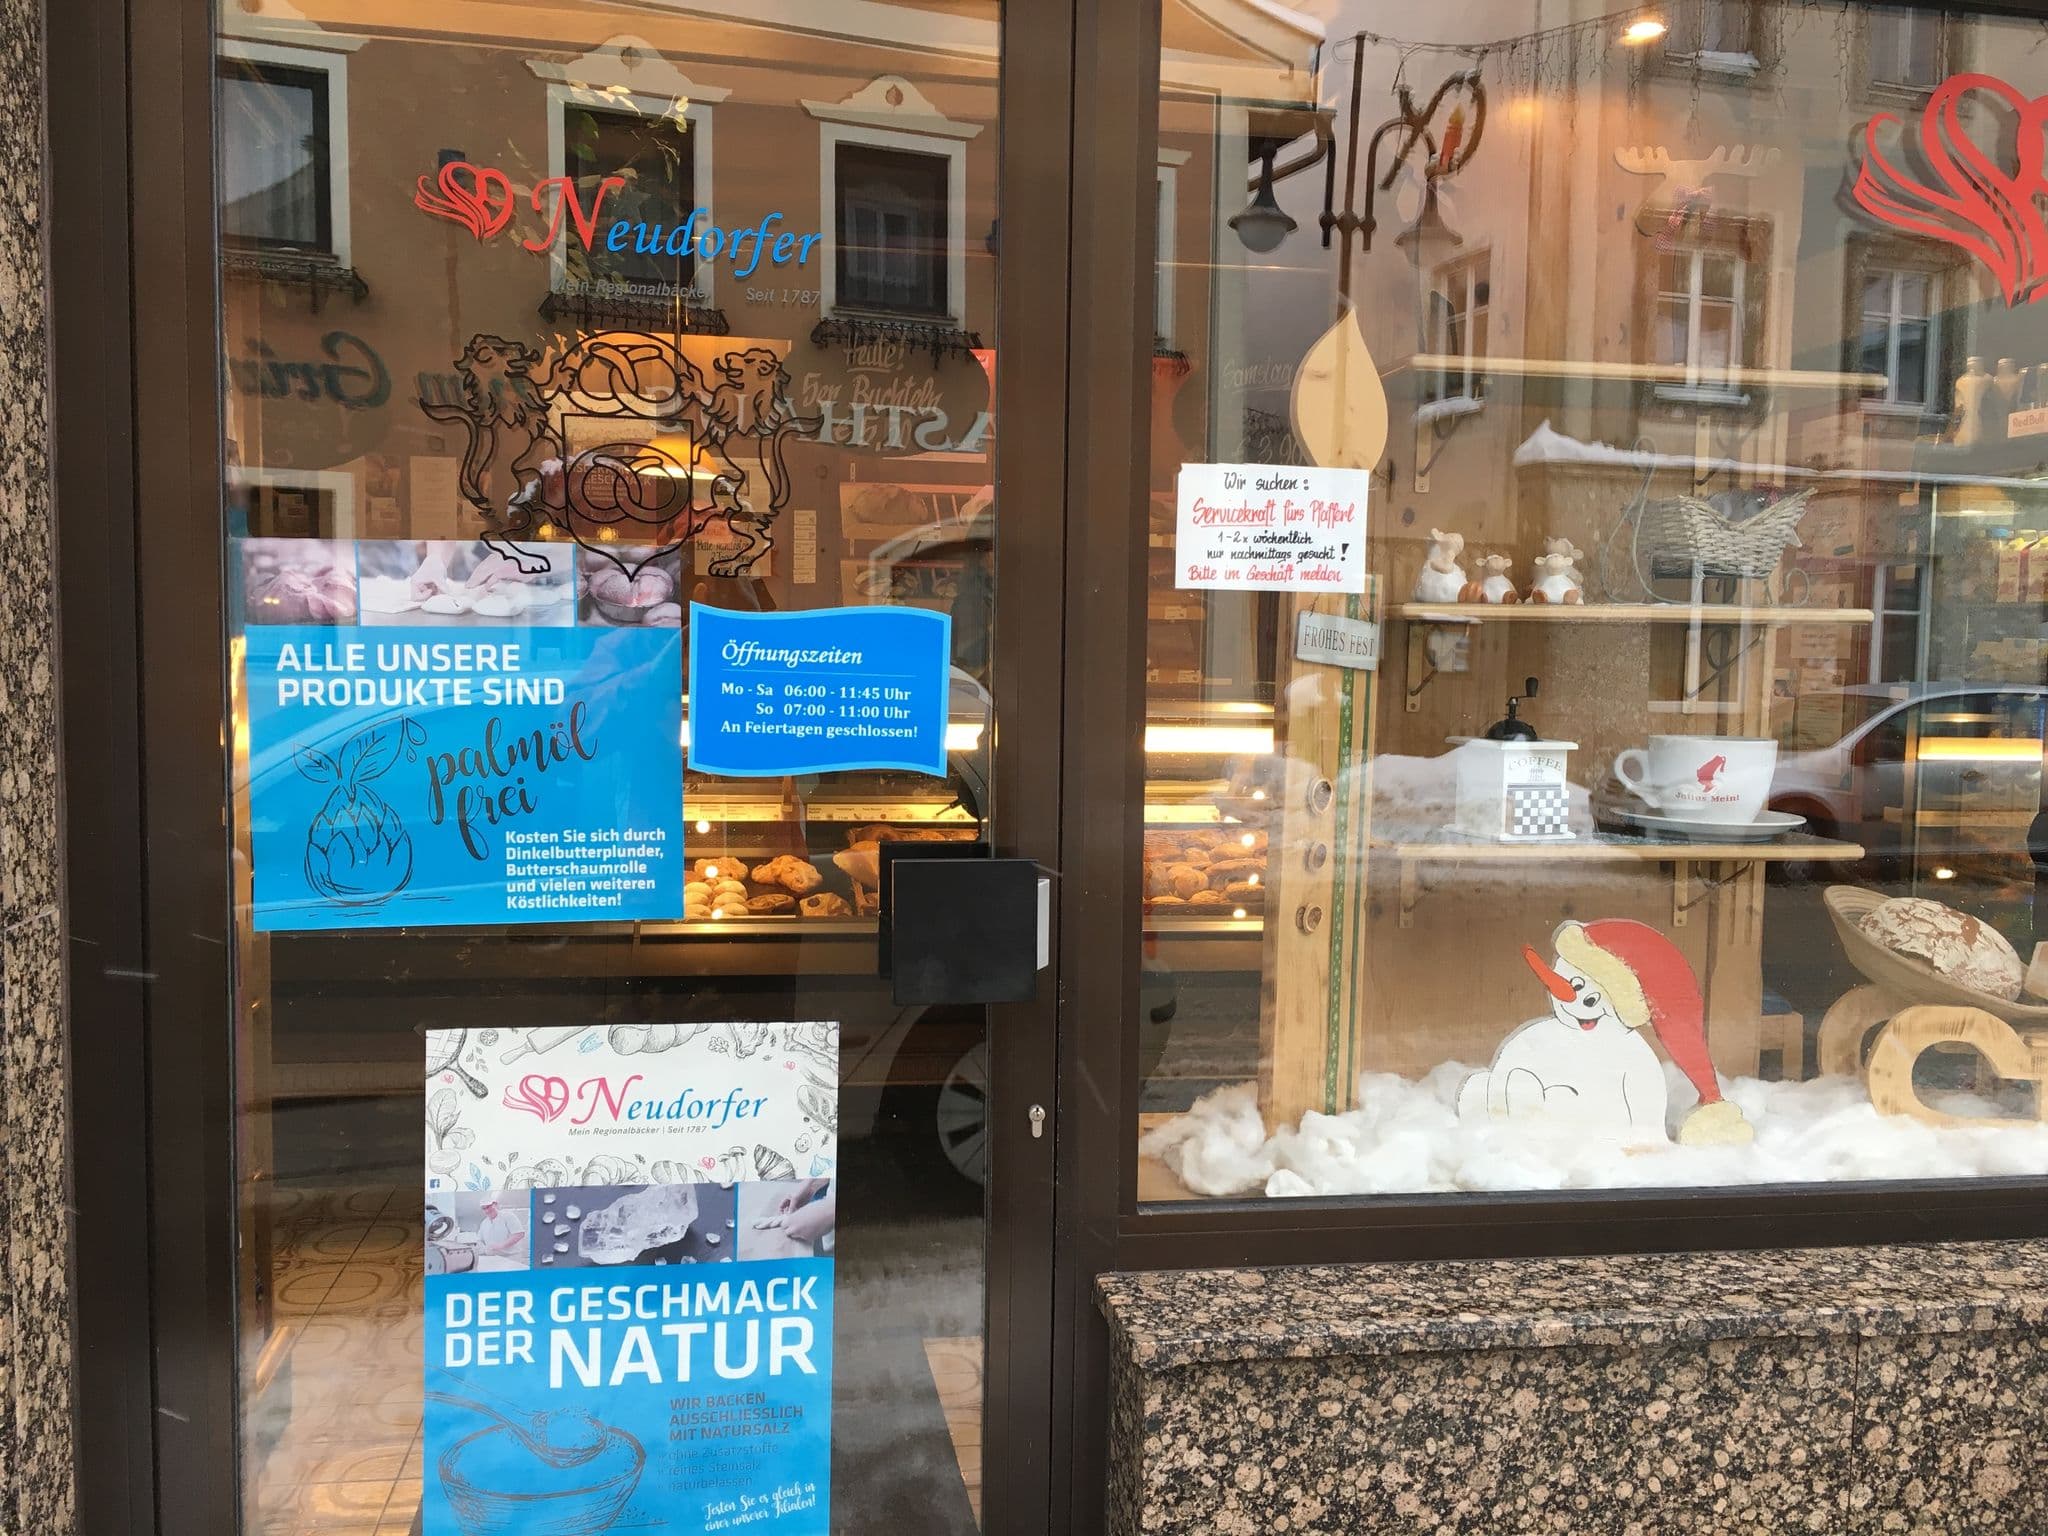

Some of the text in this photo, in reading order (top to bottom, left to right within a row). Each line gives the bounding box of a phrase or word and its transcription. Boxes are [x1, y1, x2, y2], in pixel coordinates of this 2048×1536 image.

[524, 176, 823, 278] Neudorfer
[745, 287, 775, 302] Seit
[781, 288, 821, 304] 1787
[1223, 472, 1247, 490] Wir
[1255, 473, 1299, 491] suchen
[1192, 497, 1276, 527] Servicekraft
[1283, 499, 1305, 527] fürs
[1253, 529, 1314, 545] wöchentlich
[1207, 549, 1225, 560] nur
[1231, 546, 1293, 564] nachmittags
[1188, 563, 1343, 583] Bitte im Geschäft melden
[1303, 625, 1375, 657] FROHES FEST
[275, 643, 521, 673] ALLE UNSERE
[721, 639, 863, 669] Öffnungszeiten
[277, 677, 566, 707] PRODUKTE SIND
[721, 682, 744, 696] Mo
[756, 683, 774, 697] Sa
[783, 684, 827, 699] 06:00
[839, 686, 880, 700] 11:45
[884, 687, 912, 701] Uhr
[755, 702, 774, 716] So
[783, 703, 826, 718] 07:00
[839, 705, 880, 719] 11:00
[883, 706, 911, 720] Uhr
[720, 720, 918, 740] An Feiertagen geschlossen!
[426, 701, 598, 825] palmöl
[1710, 793, 1740, 803] Meinl
[456, 776, 538, 861] frei
[505, 828, 666, 844] Kosten Sie sich durch
[505, 845, 665, 862] Dinkelbutterplunder,
[506, 861, 648, 877] Butterschaumrolle
[506, 877, 656, 893] und vielen weiteren
[506, 893, 622, 909] Köstlichkeiten!
[570, 1074, 769, 1130] Neudorfer
[568, 1125, 707, 1137] Mein Regionalbäcker Seit 1787
[445, 1275, 819, 1329] DER GESCHMACK
[445, 1316, 819, 1390] DER NATUR
[670, 1392, 766, 1411] WIR BACKEN
[669, 1405, 804, 1427] AUSSCHLIESSLICH
[669, 1422, 790, 1441] MIT NATURSALZ
[705, 1481, 816, 1521] Testen Sie es gleich in
[732, 1511, 770, 1528] unserer
[771, 1494, 817, 1519] Filialen!
